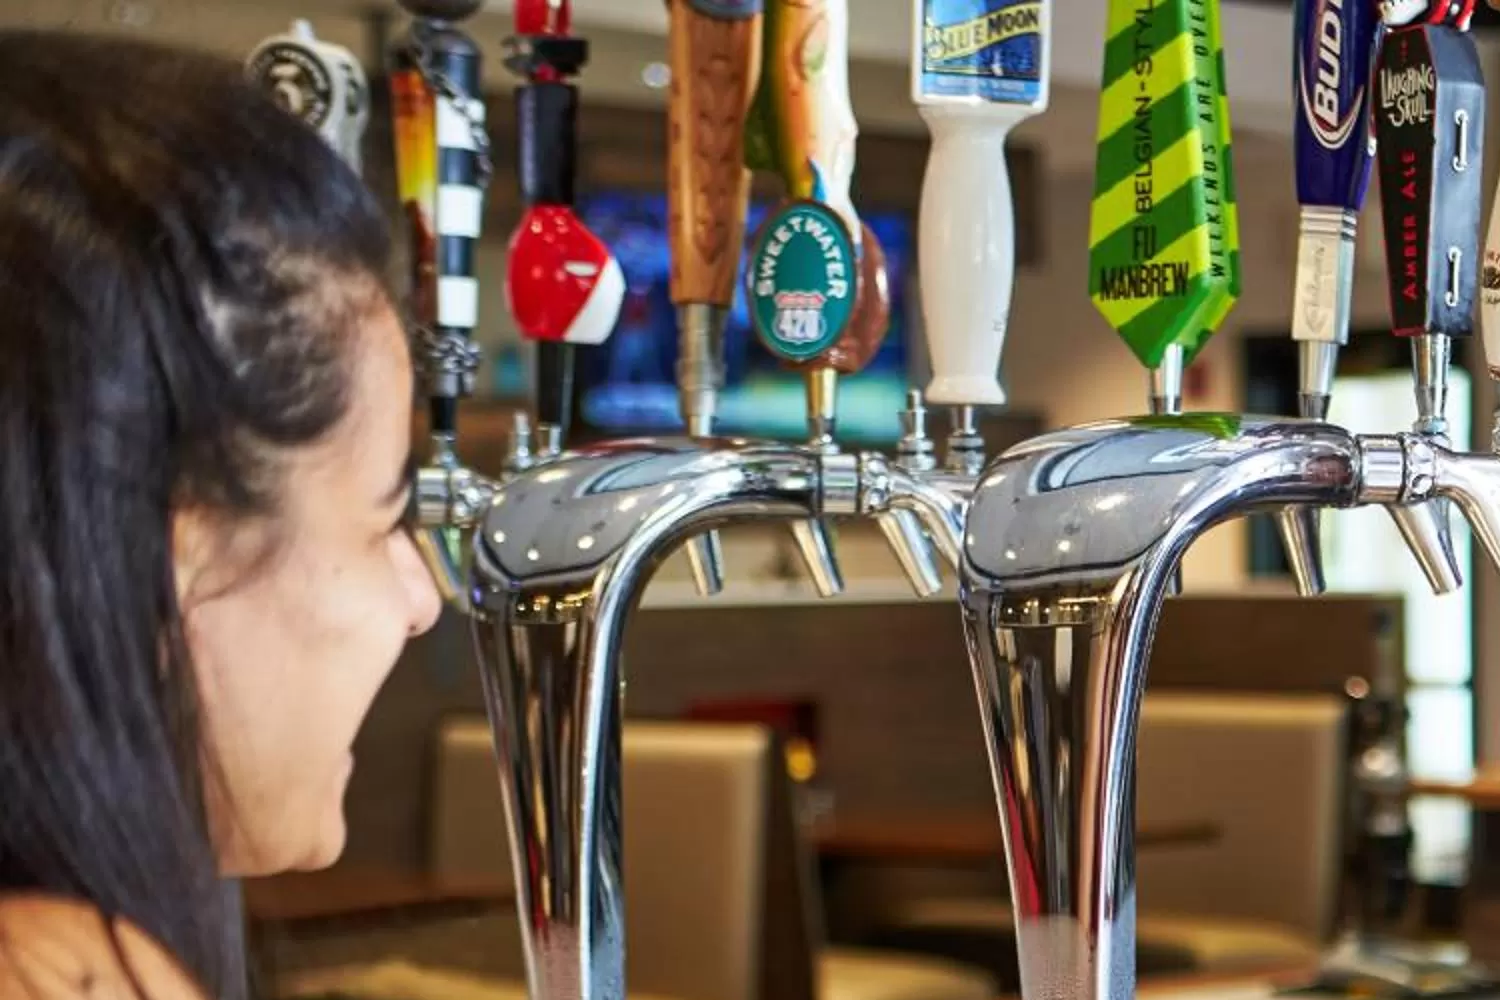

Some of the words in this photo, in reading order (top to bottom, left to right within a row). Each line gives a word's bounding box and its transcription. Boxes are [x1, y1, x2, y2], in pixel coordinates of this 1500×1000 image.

[987, 8, 1039, 40] MOON
[1195, 77, 1215, 123] ARE
[1387, 95, 1437, 127] SKULL
[1400, 151, 1416, 199] ALE
[1201, 143, 1225, 278] WEEKENDS
[755, 215, 849, 299] SWEETWATER
[1133, 224, 1157, 262] FU
[1402, 214, 1418, 300] AMBER
[1100, 261, 1189, 301] MANBREW
[779, 308, 822, 339] 420
